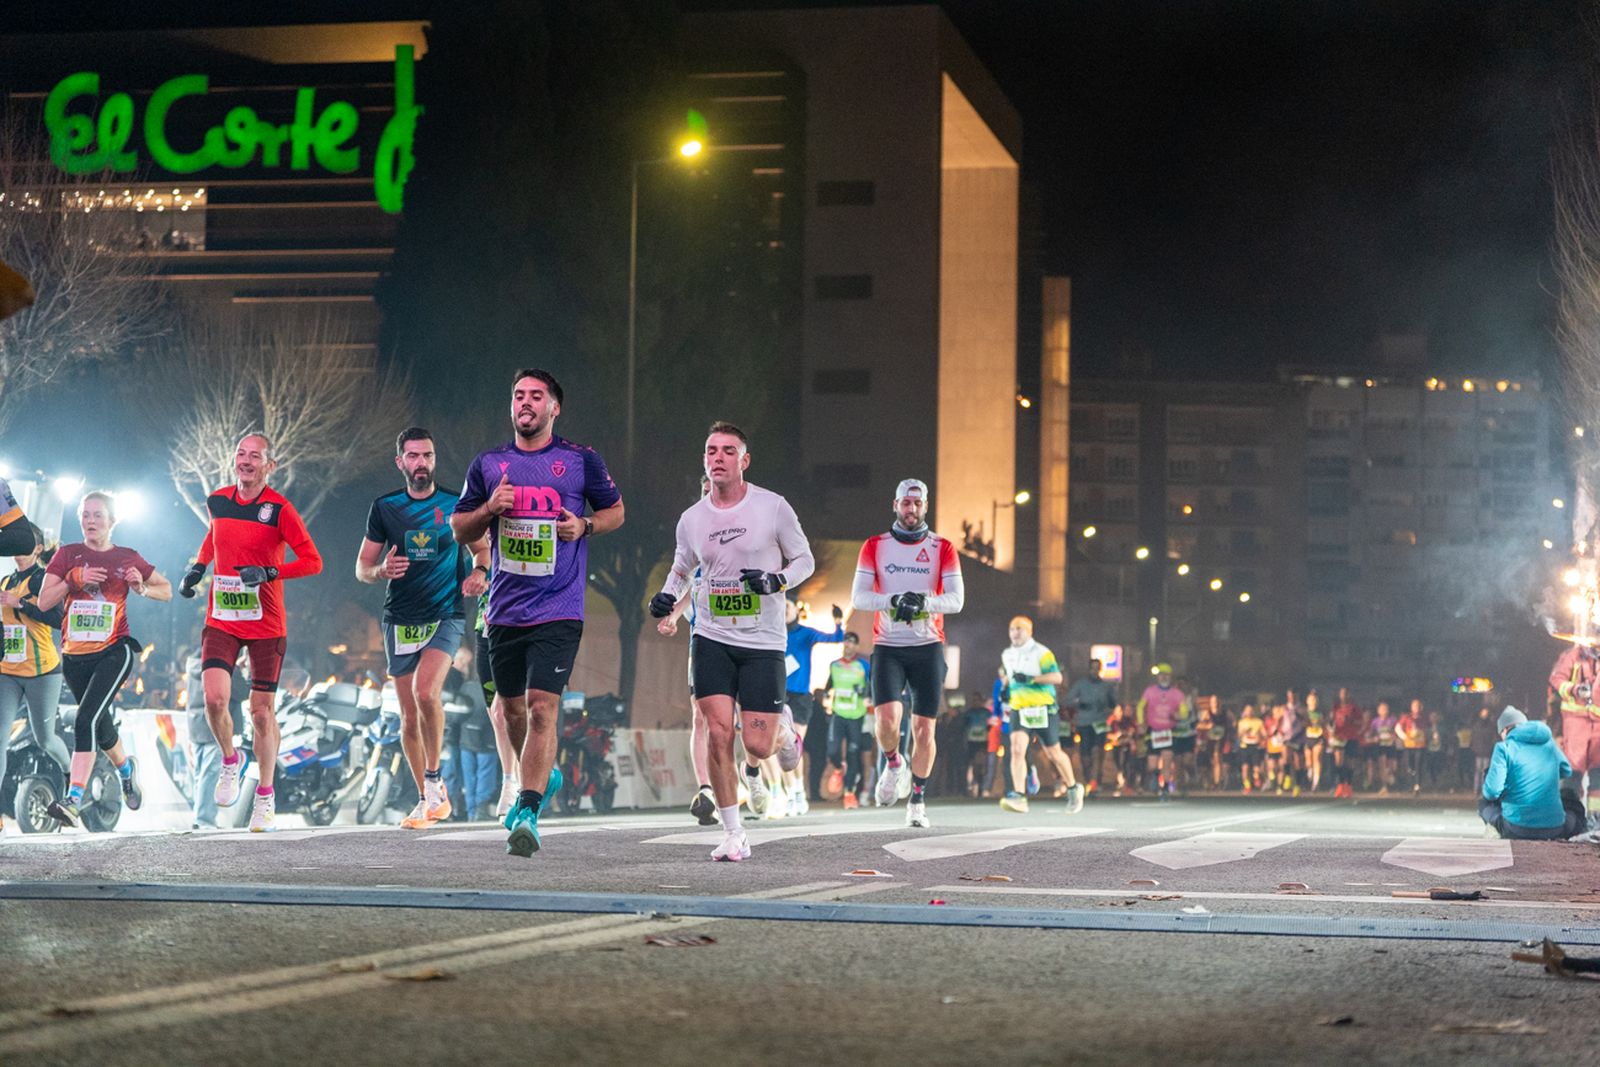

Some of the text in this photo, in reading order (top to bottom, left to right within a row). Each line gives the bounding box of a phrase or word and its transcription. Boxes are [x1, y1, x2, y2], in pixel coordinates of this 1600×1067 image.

[45, 72, 138, 173] El
[144, 75, 360, 173] Corte
[709, 530, 727, 541] NIKE
[508, 538, 543, 557] 2415
[222, 592, 249, 606] 3017
[716, 594, 753, 611] 4259
[76, 614, 105, 628] 8576
